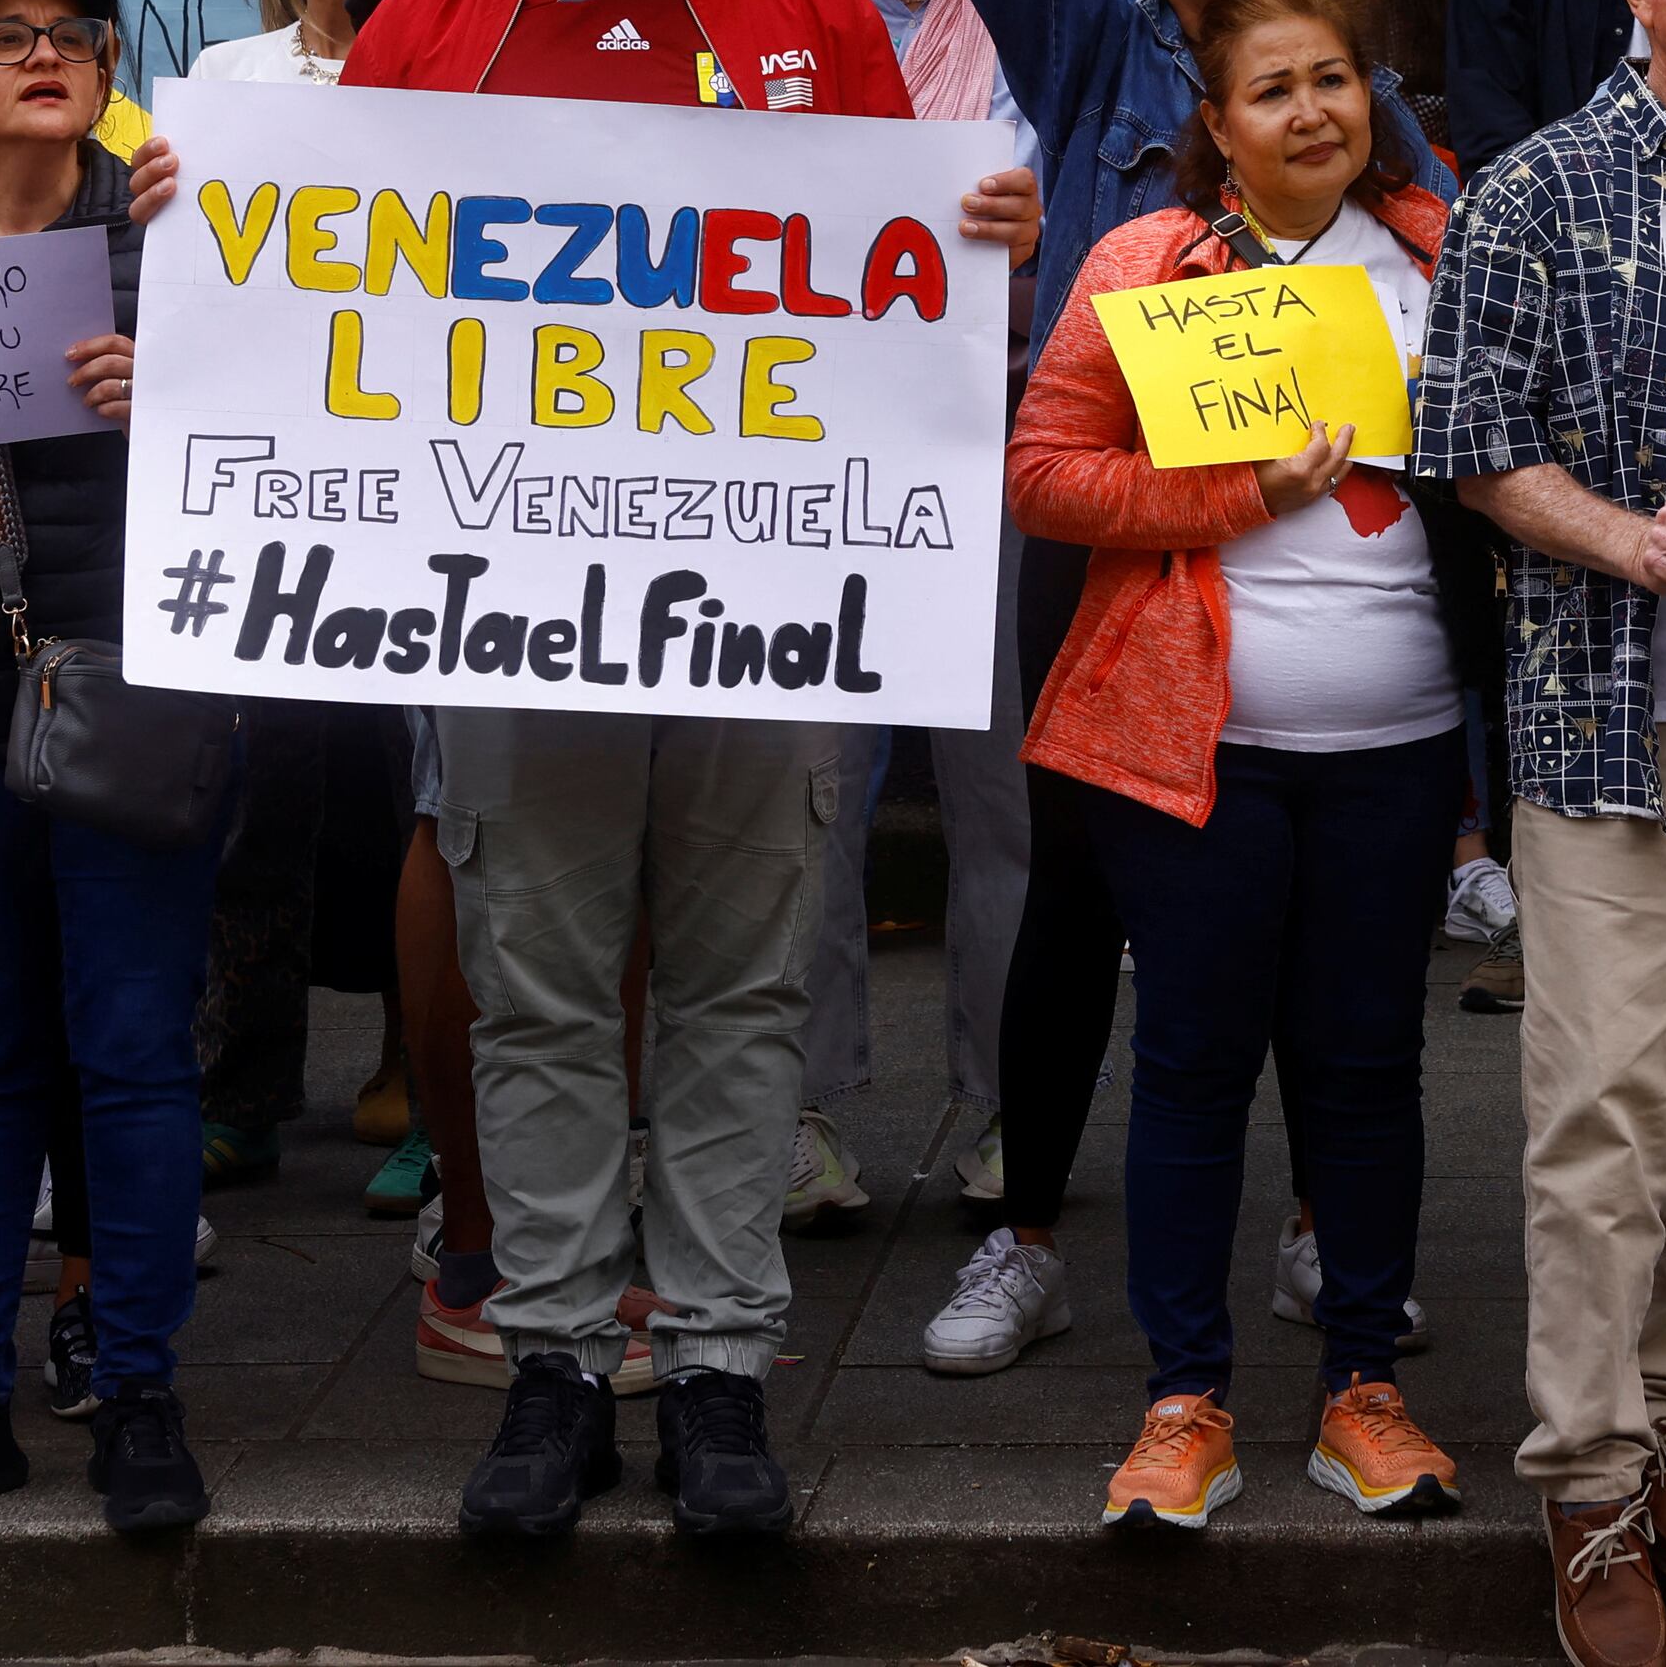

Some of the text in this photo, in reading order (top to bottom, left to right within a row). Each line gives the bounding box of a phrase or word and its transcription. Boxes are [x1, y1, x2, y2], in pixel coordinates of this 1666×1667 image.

[596, 38, 650, 51] adidas
[197, 179, 949, 323] VENEZUELA
[1139, 284, 1316, 333] HASTA
[1209, 332, 1282, 361] EL
[324, 309, 825, 441] LIBRE
[181, 434, 954, 550] FREE VENEZUELA
[1158, 1404, 1183, 1416] HOKA
